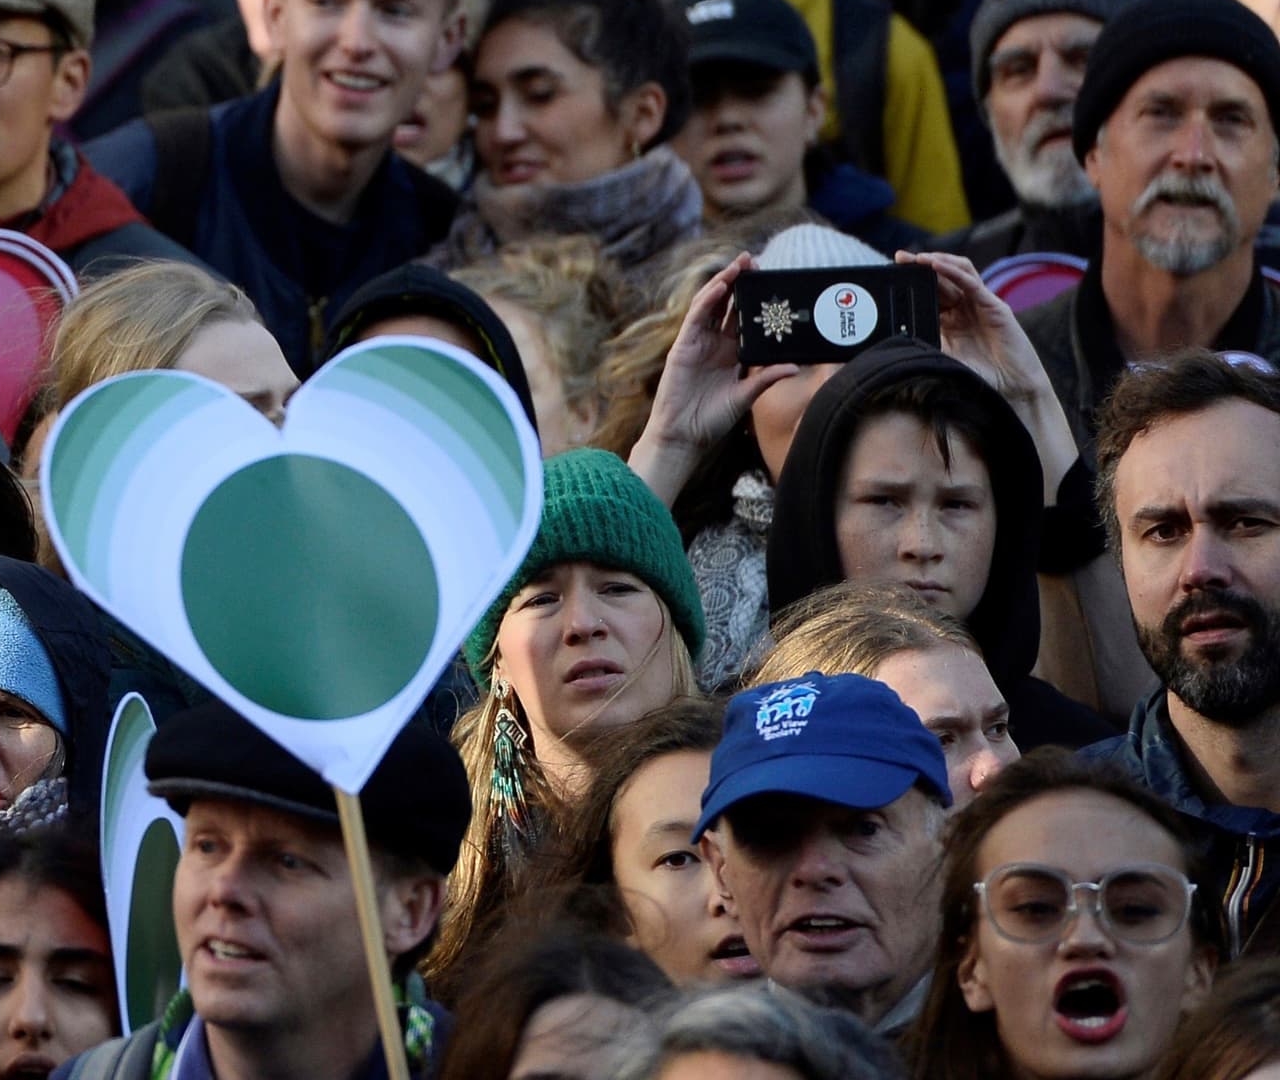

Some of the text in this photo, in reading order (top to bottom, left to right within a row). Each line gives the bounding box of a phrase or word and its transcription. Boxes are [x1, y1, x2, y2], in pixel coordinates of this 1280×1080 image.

[847, 311, 856, 337] FACE
[782, 720, 808, 729] View
[764, 727, 802, 740] Society
